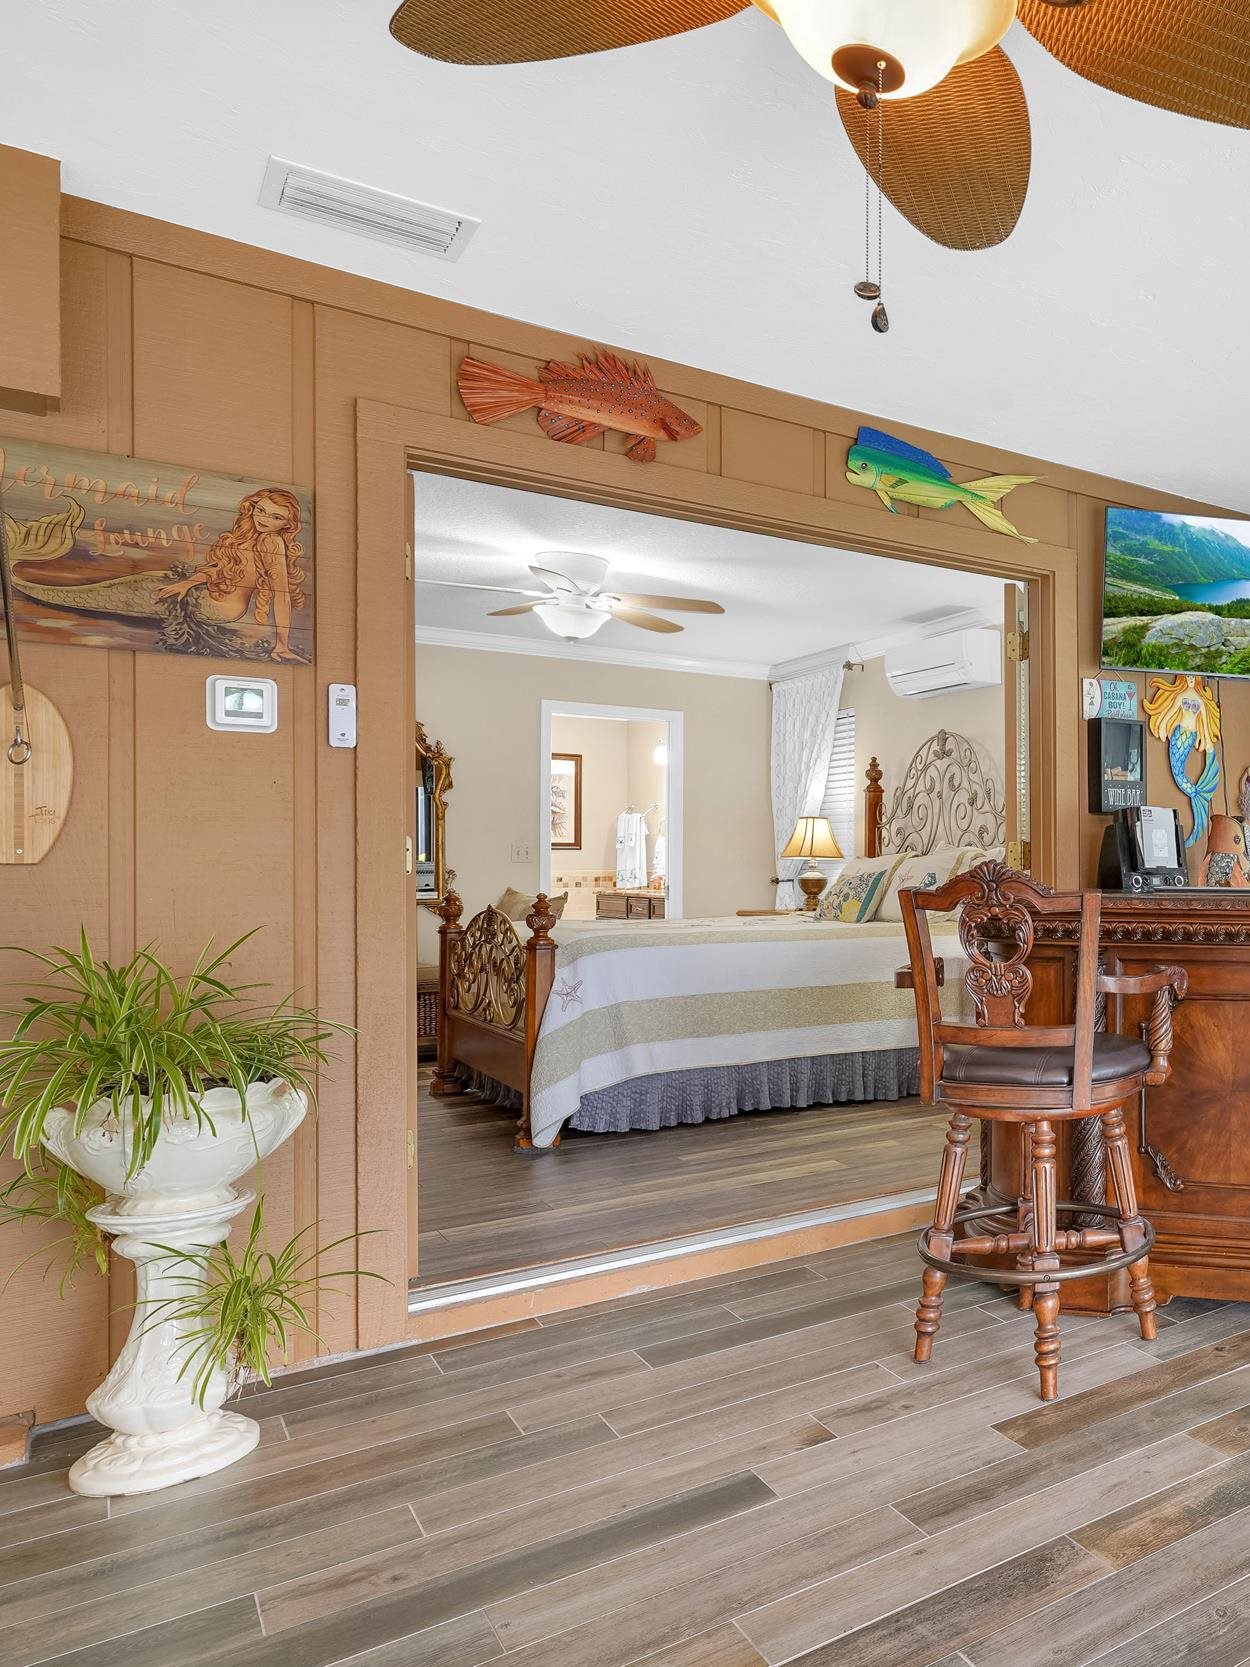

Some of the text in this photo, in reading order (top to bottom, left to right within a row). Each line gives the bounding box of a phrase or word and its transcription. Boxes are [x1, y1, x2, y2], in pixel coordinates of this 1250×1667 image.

[0, 447, 201, 515] ermaid
[76, 517, 210, 561] Lounge
[1103, 691, 1127, 701] CABANA
[1108, 701, 1126, 710] BOY!
[1108, 788, 1141, 806] WINE BAR
